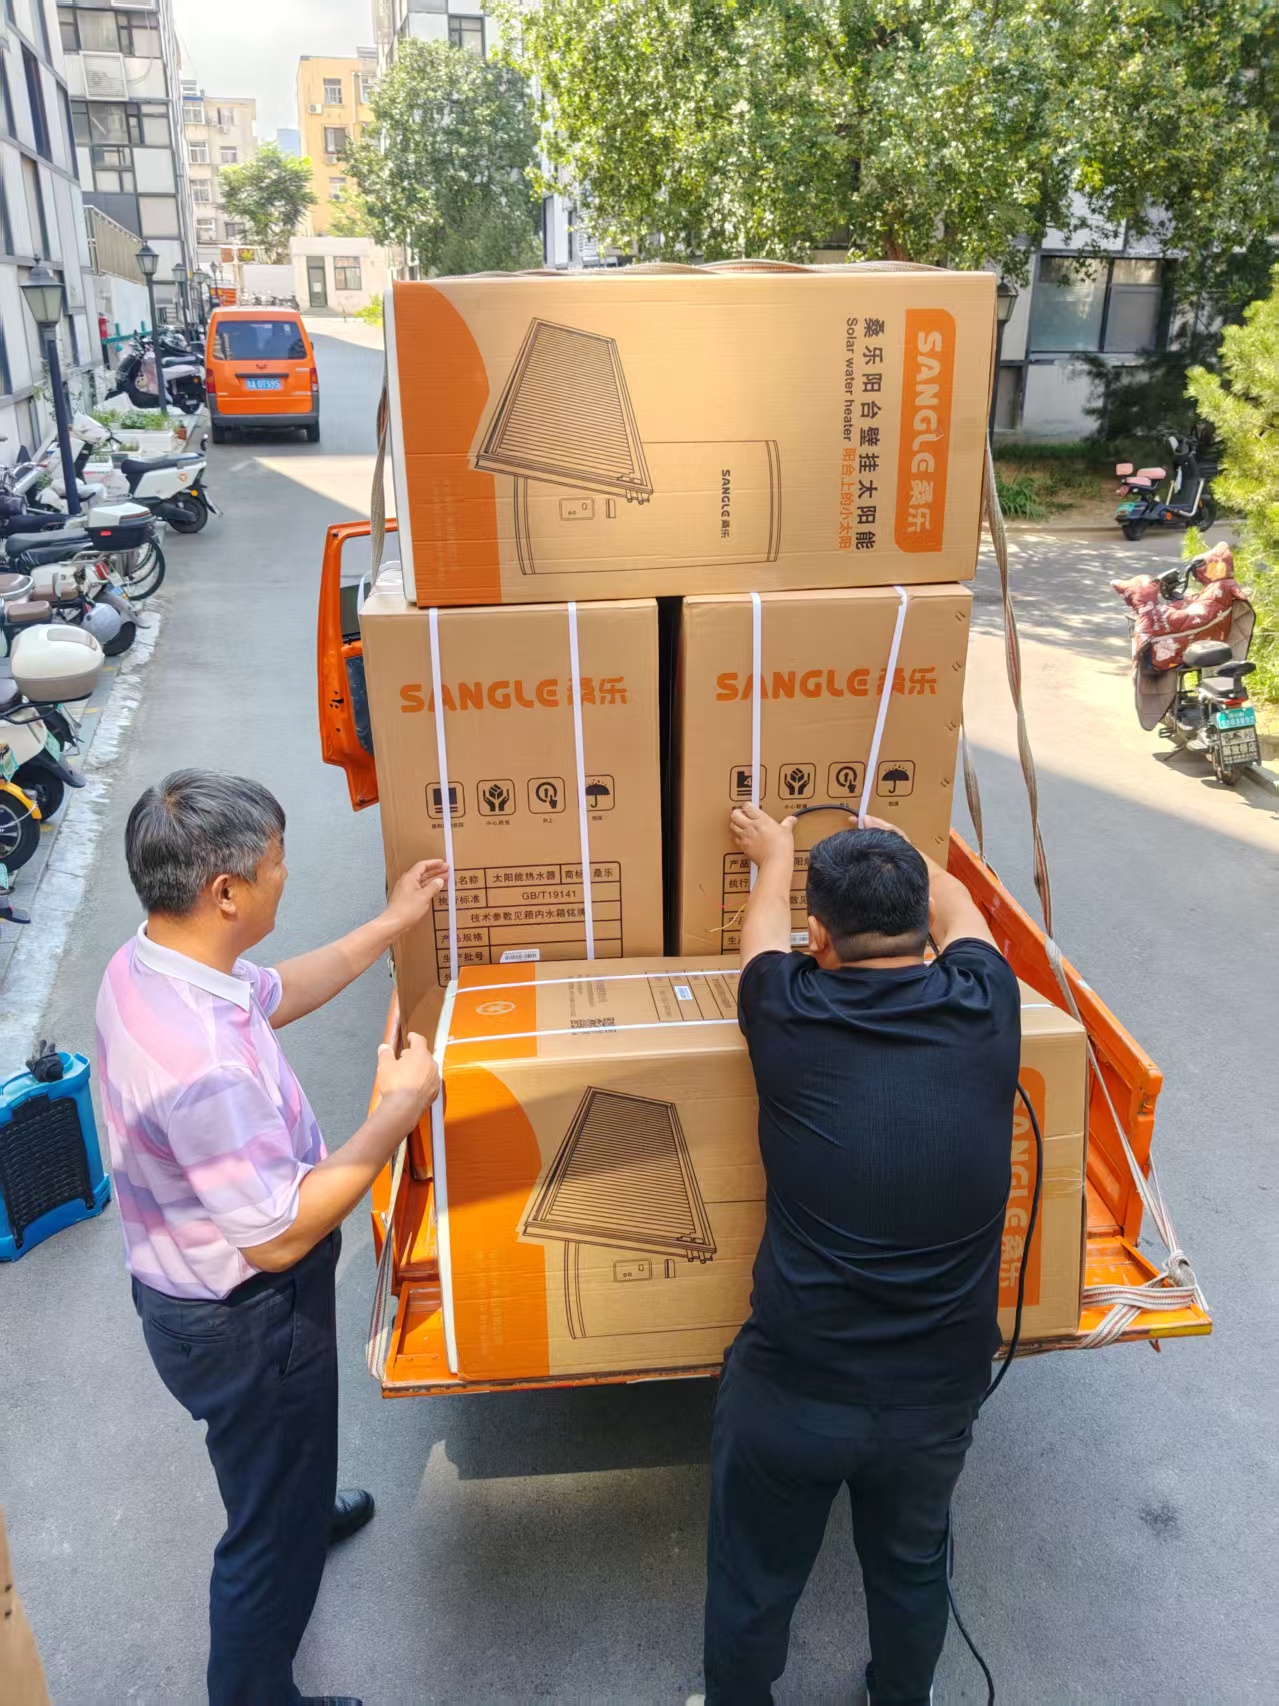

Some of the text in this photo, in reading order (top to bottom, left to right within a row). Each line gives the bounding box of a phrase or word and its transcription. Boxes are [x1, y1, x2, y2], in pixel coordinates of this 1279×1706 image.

[842, 316, 857, 442] Solar water heater
[855, 317, 885, 550] 桑乐阳台壁挂太阳能
[906, 331, 943, 532] SANGLE 桑乐
[721, 469, 731, 518] SANGLE
[838, 448, 856, 550] 阳台上的小太阳
[400, 677, 627, 713] SANGLE 桑乐
[716, 666, 937, 701] SANGLE 桑乐
[455, 874, 480, 886] 名称
[492, 871, 556, 883] 太阳能热水器
[564, 869, 583, 880] 商标
[593, 868, 613, 878] 桑乐
[522, 889, 577, 900] GB/T19141
[470, 907, 585, 923] 技术参数见箱内水箱铭牌
